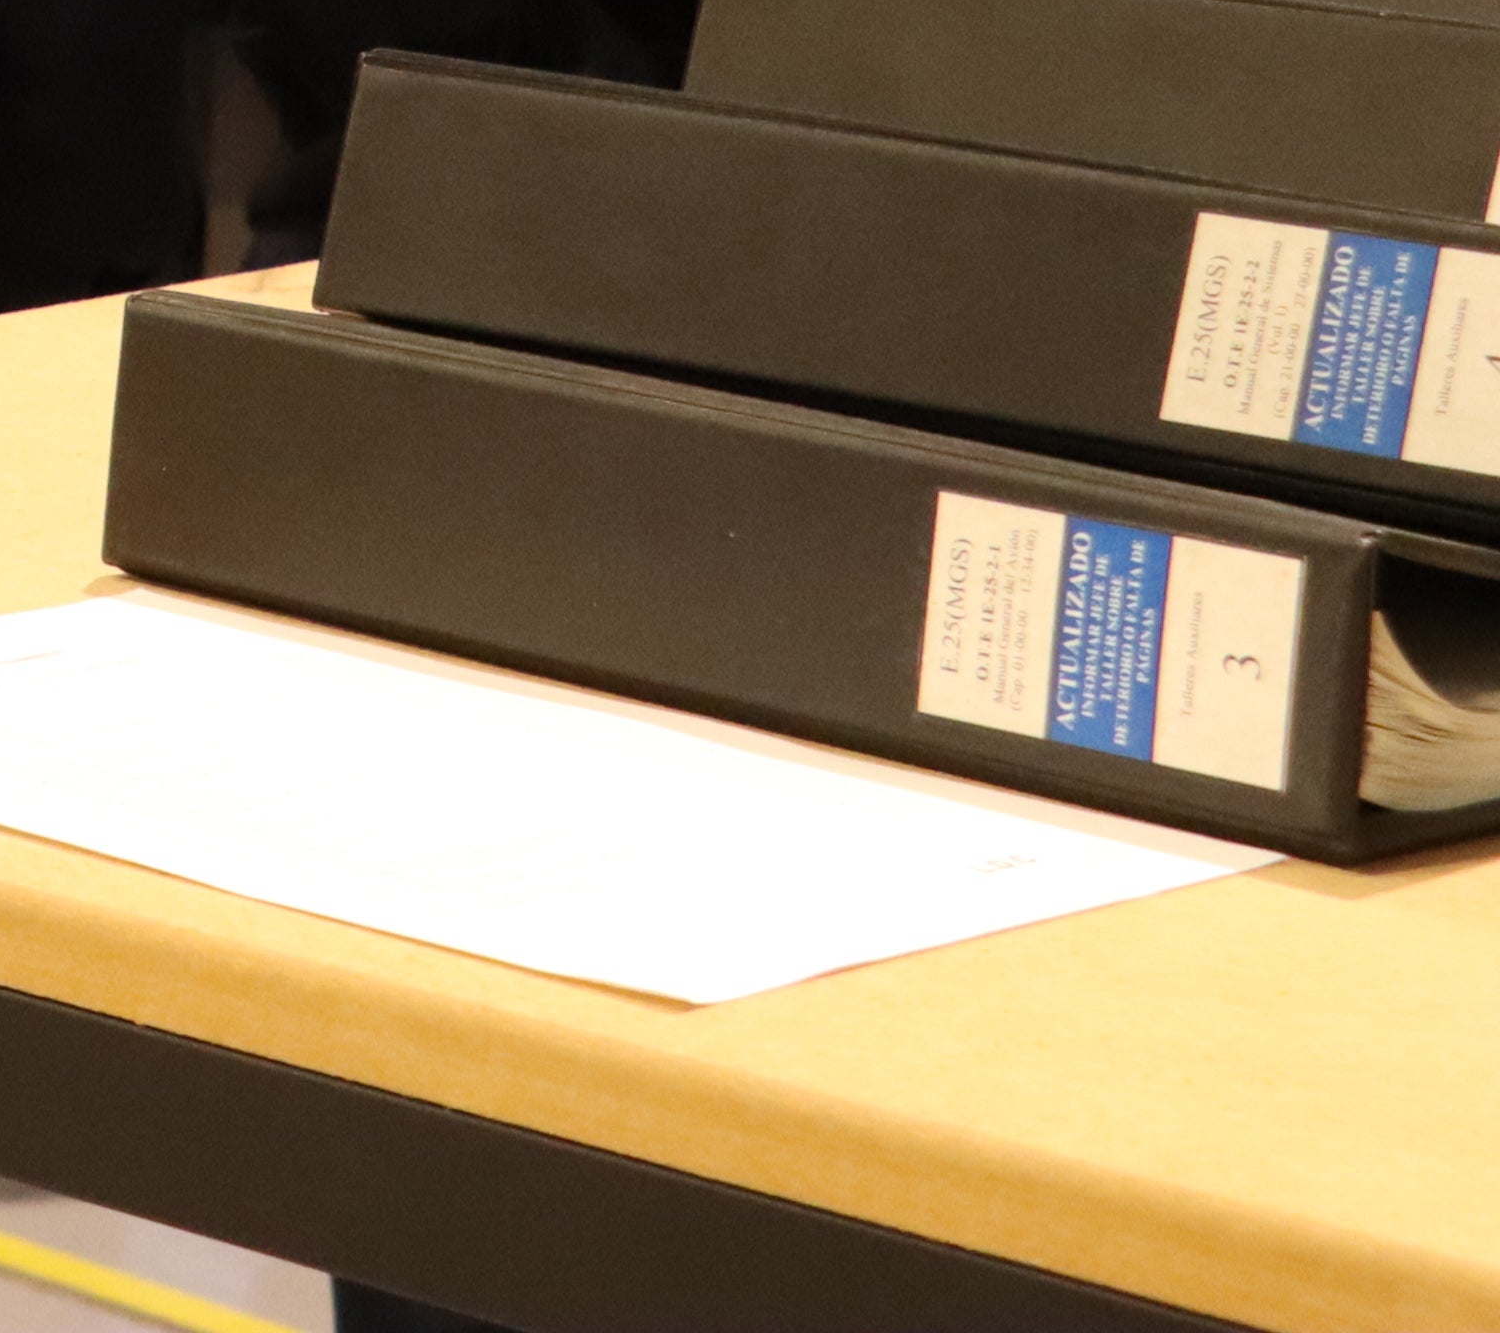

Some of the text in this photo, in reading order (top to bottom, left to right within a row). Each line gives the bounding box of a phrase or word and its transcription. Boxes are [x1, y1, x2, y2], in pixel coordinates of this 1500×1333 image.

[1393, 250, 1411, 274] DE
[1185, 252, 1231, 383] E.25(MGS)
[1246, 315, 1268, 365] General
[1256, 297, 1271, 312] de
[1301, 243, 1355, 431] ACTUALIZADO
[1330, 264, 1372, 420] INFORMAR JEFE DE
[1382, 275, 1406, 330] FALTA
[1222, 340, 1245, 389] O.T.E
[1351, 283, 1386, 403] TALLER SOBRE
[1237, 367, 1258, 415] Manual
[1361, 347, 1392, 444] DETERIORO
[939, 535, 972, 674] E.25(MGS)
[997, 597, 1014, 650] General
[1053, 529, 1092, 731] ACTUALIZADO
[1080, 551, 1109, 718] INFORMAR JEFE DE
[1098, 573, 1123, 701] TALLER SOBRE
[1112, 537, 1145, 746] DETERIORO O FALTA DE
[975, 629, 993, 681] O.T.E
[992, 652, 1009, 704] Manual
[1133, 605, 1155, 684] PÁGINAS
[1221, 650, 1261, 682] 3
